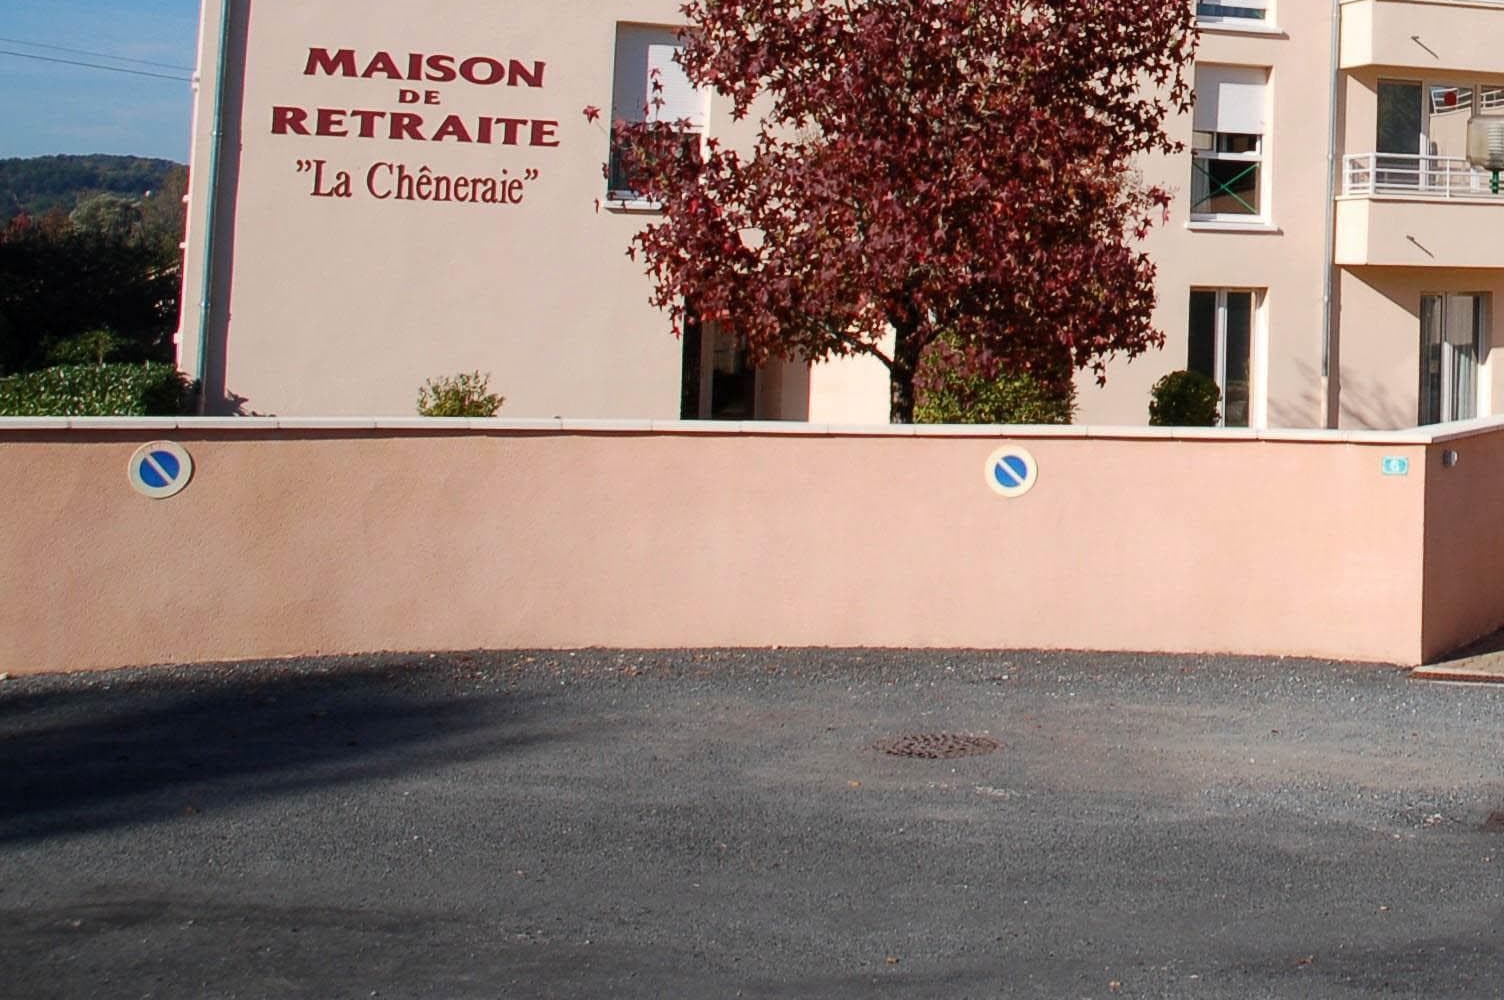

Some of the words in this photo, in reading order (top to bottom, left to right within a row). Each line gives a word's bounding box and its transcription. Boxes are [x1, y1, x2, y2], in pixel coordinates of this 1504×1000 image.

[303, 47, 546, 88] MAISON
[398, 88, 441, 106] DE
[271, 105, 561, 148] RETRAITE
